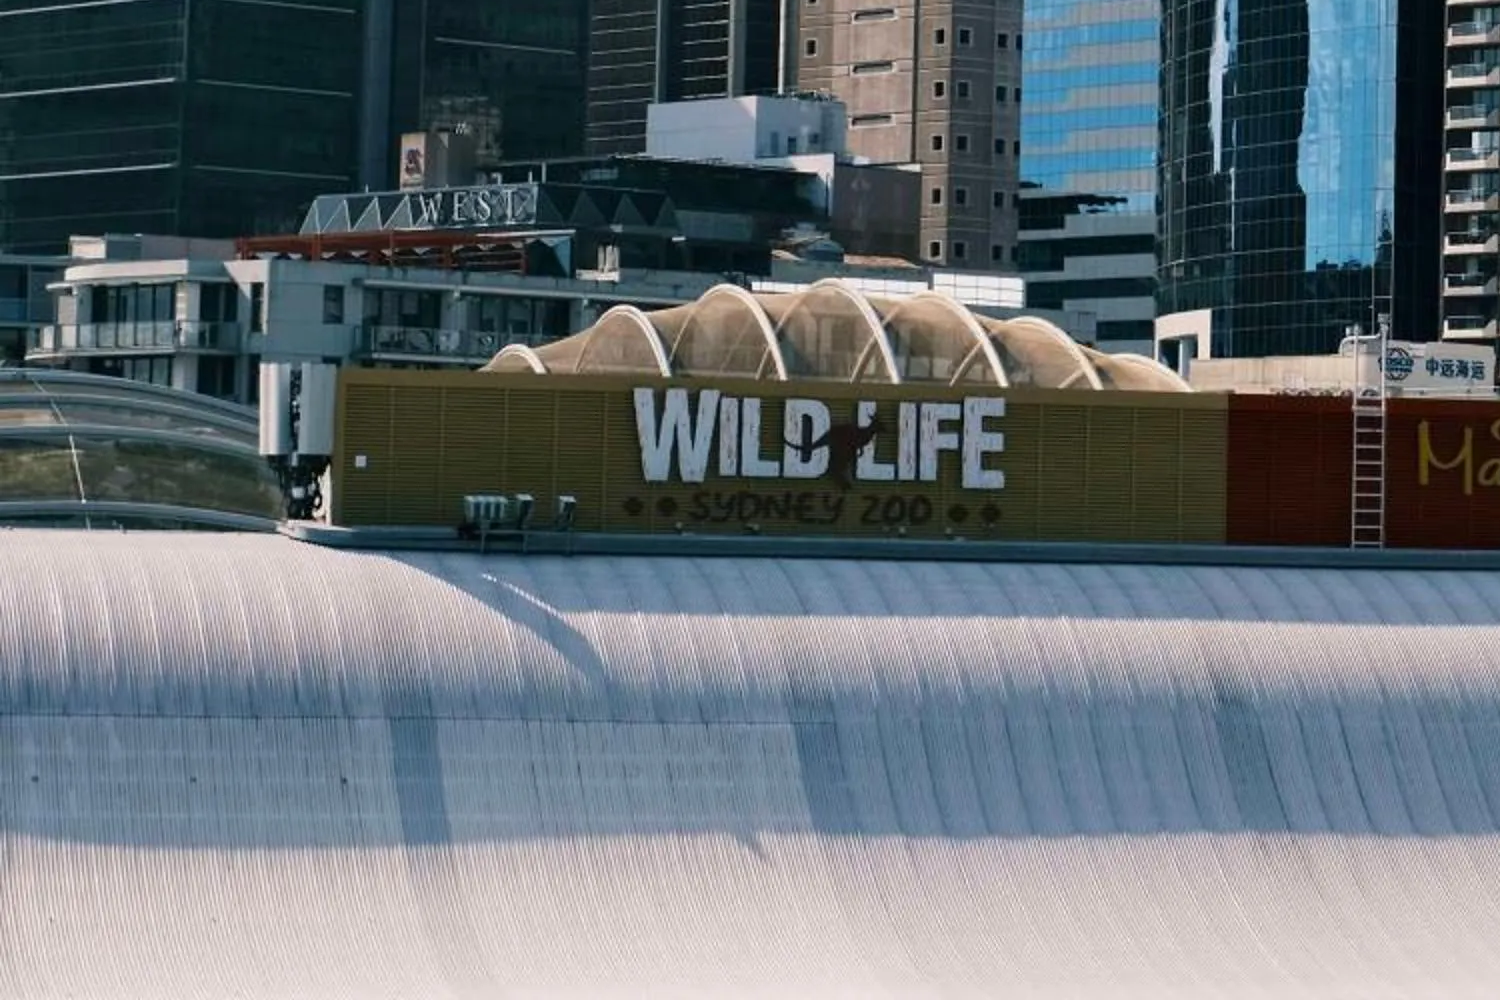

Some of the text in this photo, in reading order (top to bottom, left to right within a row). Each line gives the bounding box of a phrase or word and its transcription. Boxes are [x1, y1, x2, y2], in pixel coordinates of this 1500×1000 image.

[419, 188, 517, 225] WEST
[633, 387, 1006, 489] WILD LIFE
[687, 490, 933, 526] SYDNEY ZOO
